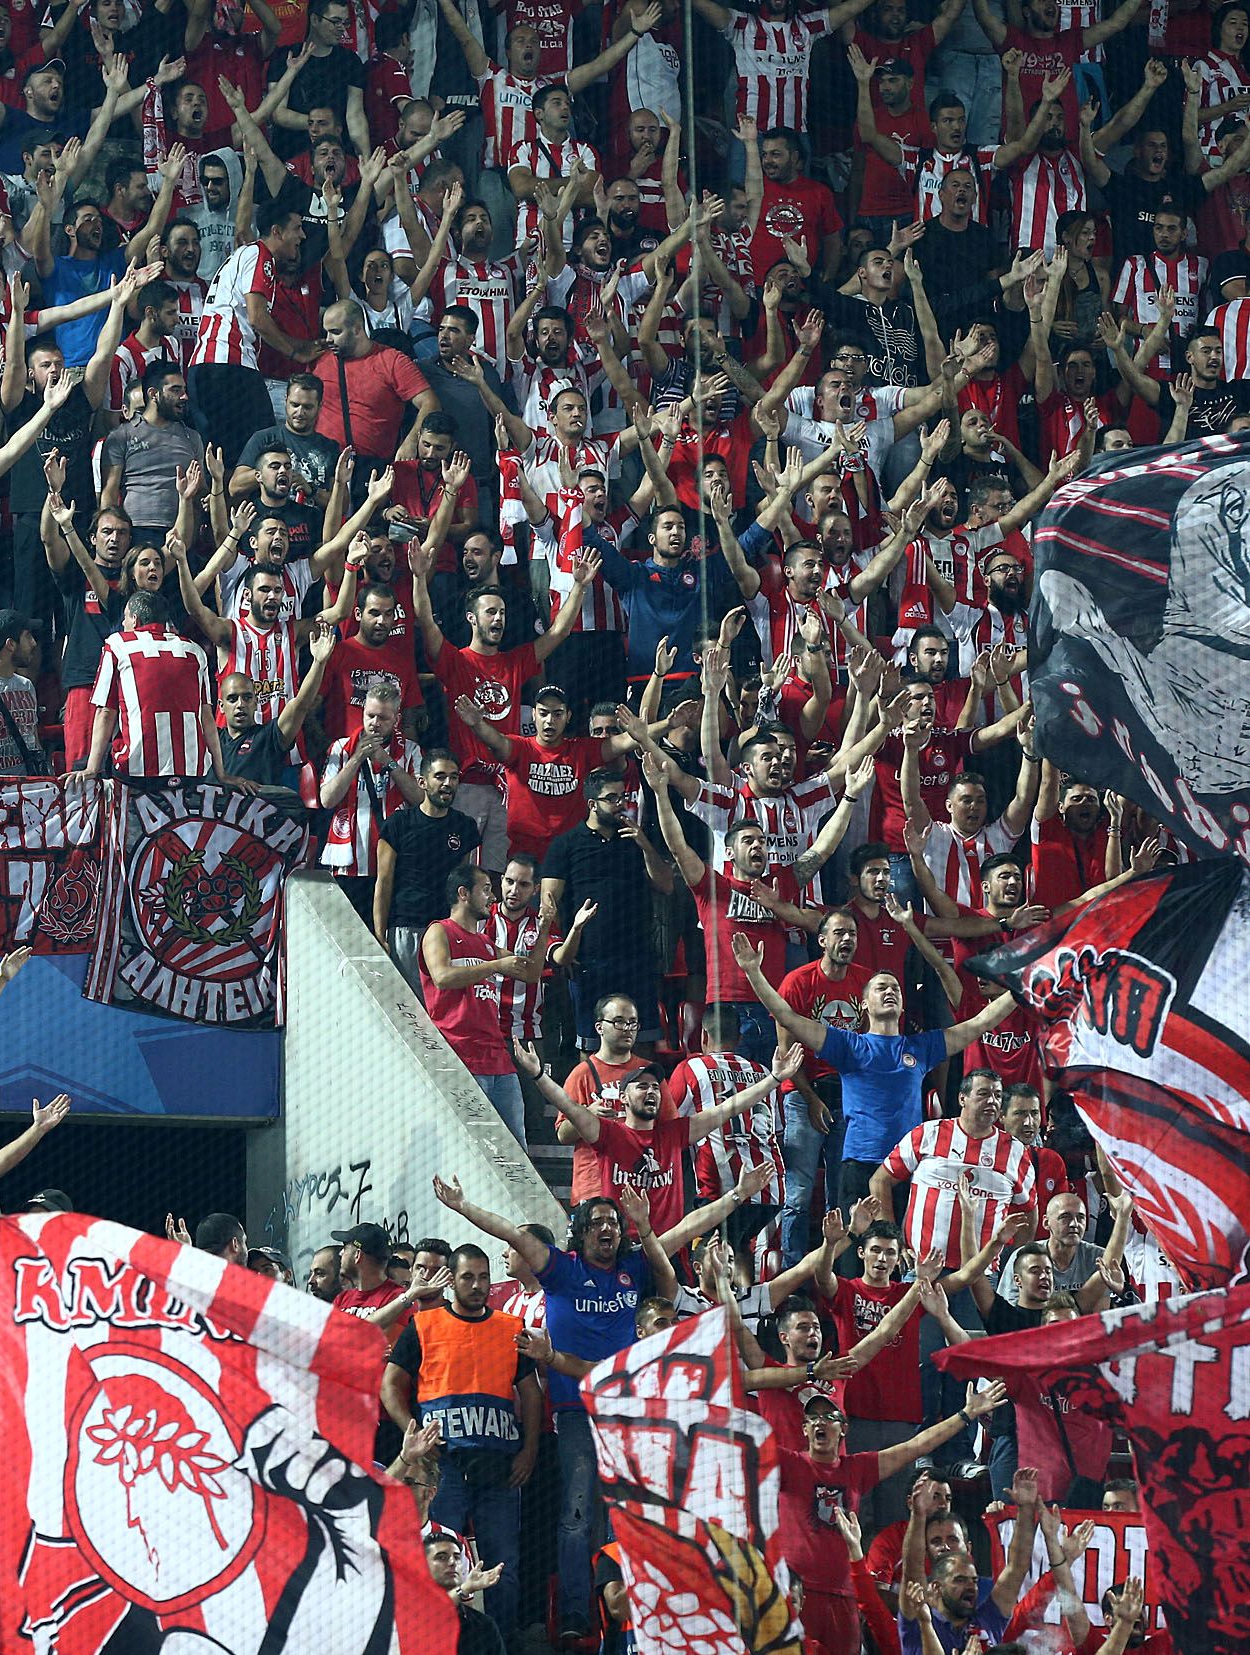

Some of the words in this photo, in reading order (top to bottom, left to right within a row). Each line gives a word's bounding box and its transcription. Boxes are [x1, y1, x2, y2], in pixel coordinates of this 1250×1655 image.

[458, 286, 509, 298] ΣΤΟΙΧΗΜΑ
[904, 611, 928, 619] adidas
[255, 649, 272, 672] 15
[9, 861, 50, 941] 7
[575, 1293, 623, 1314] unicef
